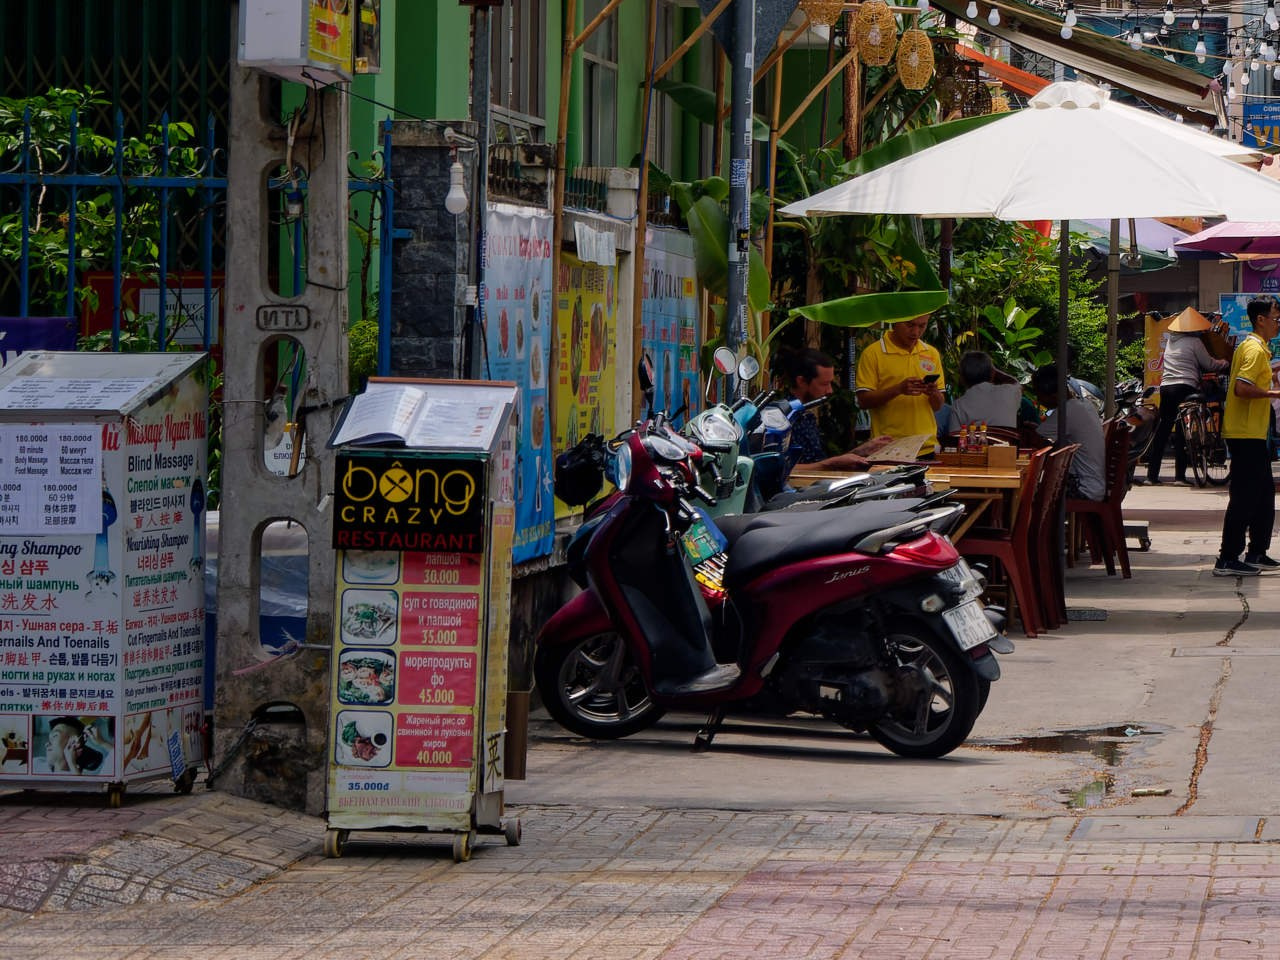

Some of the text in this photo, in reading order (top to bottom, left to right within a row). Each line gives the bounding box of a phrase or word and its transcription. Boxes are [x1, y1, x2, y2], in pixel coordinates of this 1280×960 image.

[15, 435, 92, 443] 180.000đ 180.000đ
[61, 447, 87, 455] 60 минут
[15, 457, 49, 466] Body Massage
[59, 457, 94, 465] Массаж тела
[127, 452, 193, 472] Blind Massage
[15, 467, 49, 476] Foot Massage
[43, 484, 77, 492] 180.000đ
[127, 475, 160, 493] Слепой
[341, 460, 476, 516] bông
[49, 493, 58, 502] 60
[162, 494, 186, 510] 마사지
[341, 505, 443, 525] CRAZY
[161, 532, 189, 549] Shampoo
[336, 530, 480, 551] RESTAURANT
[21, 540, 83, 559] Shampoo
[20, 559, 49, 575] 샴푸
[159, 551, 175, 569] 샴푸
[425, 553, 462, 566] лапшой
[423, 569, 460, 585] 30.000
[27, 580, 80, 593] шампунь
[404, 595, 478, 611] суп с говядиной
[22, 619, 85, 633] Ушная сера
[418, 613, 462, 628] и лапшой
[168, 627, 179, 640] And
[420, 629, 458, 645] 35.000
[37, 637, 110, 648] And Toenails
[91, 653, 118, 667] 다듬기
[404, 656, 473, 670] морепродукты
[1, 670, 115, 684] ногти на руках и ногах
[430, 673, 445, 688] фо
[418, 689, 455, 704] 45.000
[416, 750, 453, 765] 40.000
[347, 782, 390, 791] 35.000đ
